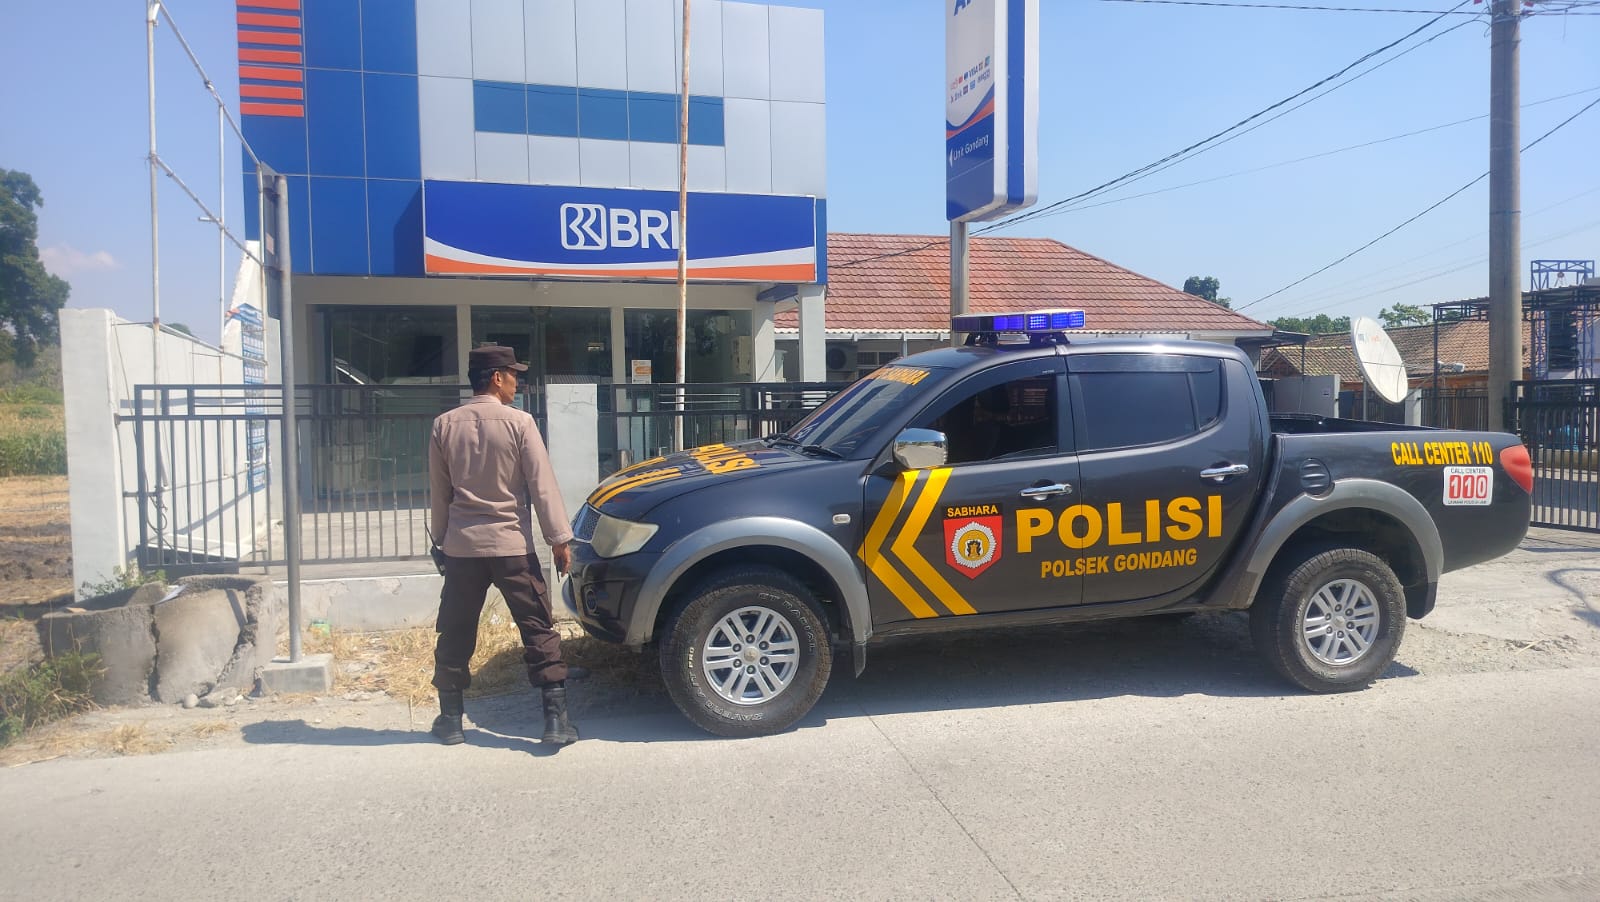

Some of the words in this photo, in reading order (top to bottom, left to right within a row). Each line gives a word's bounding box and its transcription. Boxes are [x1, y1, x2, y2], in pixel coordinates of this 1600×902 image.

[953, 145, 964, 161] Unit
[965, 134, 989, 155] Gondang
[609, 208, 680, 250] BRI
[1391, 441, 1424, 465] CALL
[1424, 441, 1472, 465] CENTER
[1472, 441, 1494, 465] 110
[1450, 476, 1487, 498] 110
[947, 504, 998, 517] SABHARA
[1016, 495, 1222, 553] POLISI
[1041, 556, 1109, 578] POLSEK
[1114, 548, 1197, 572] GONDANG
